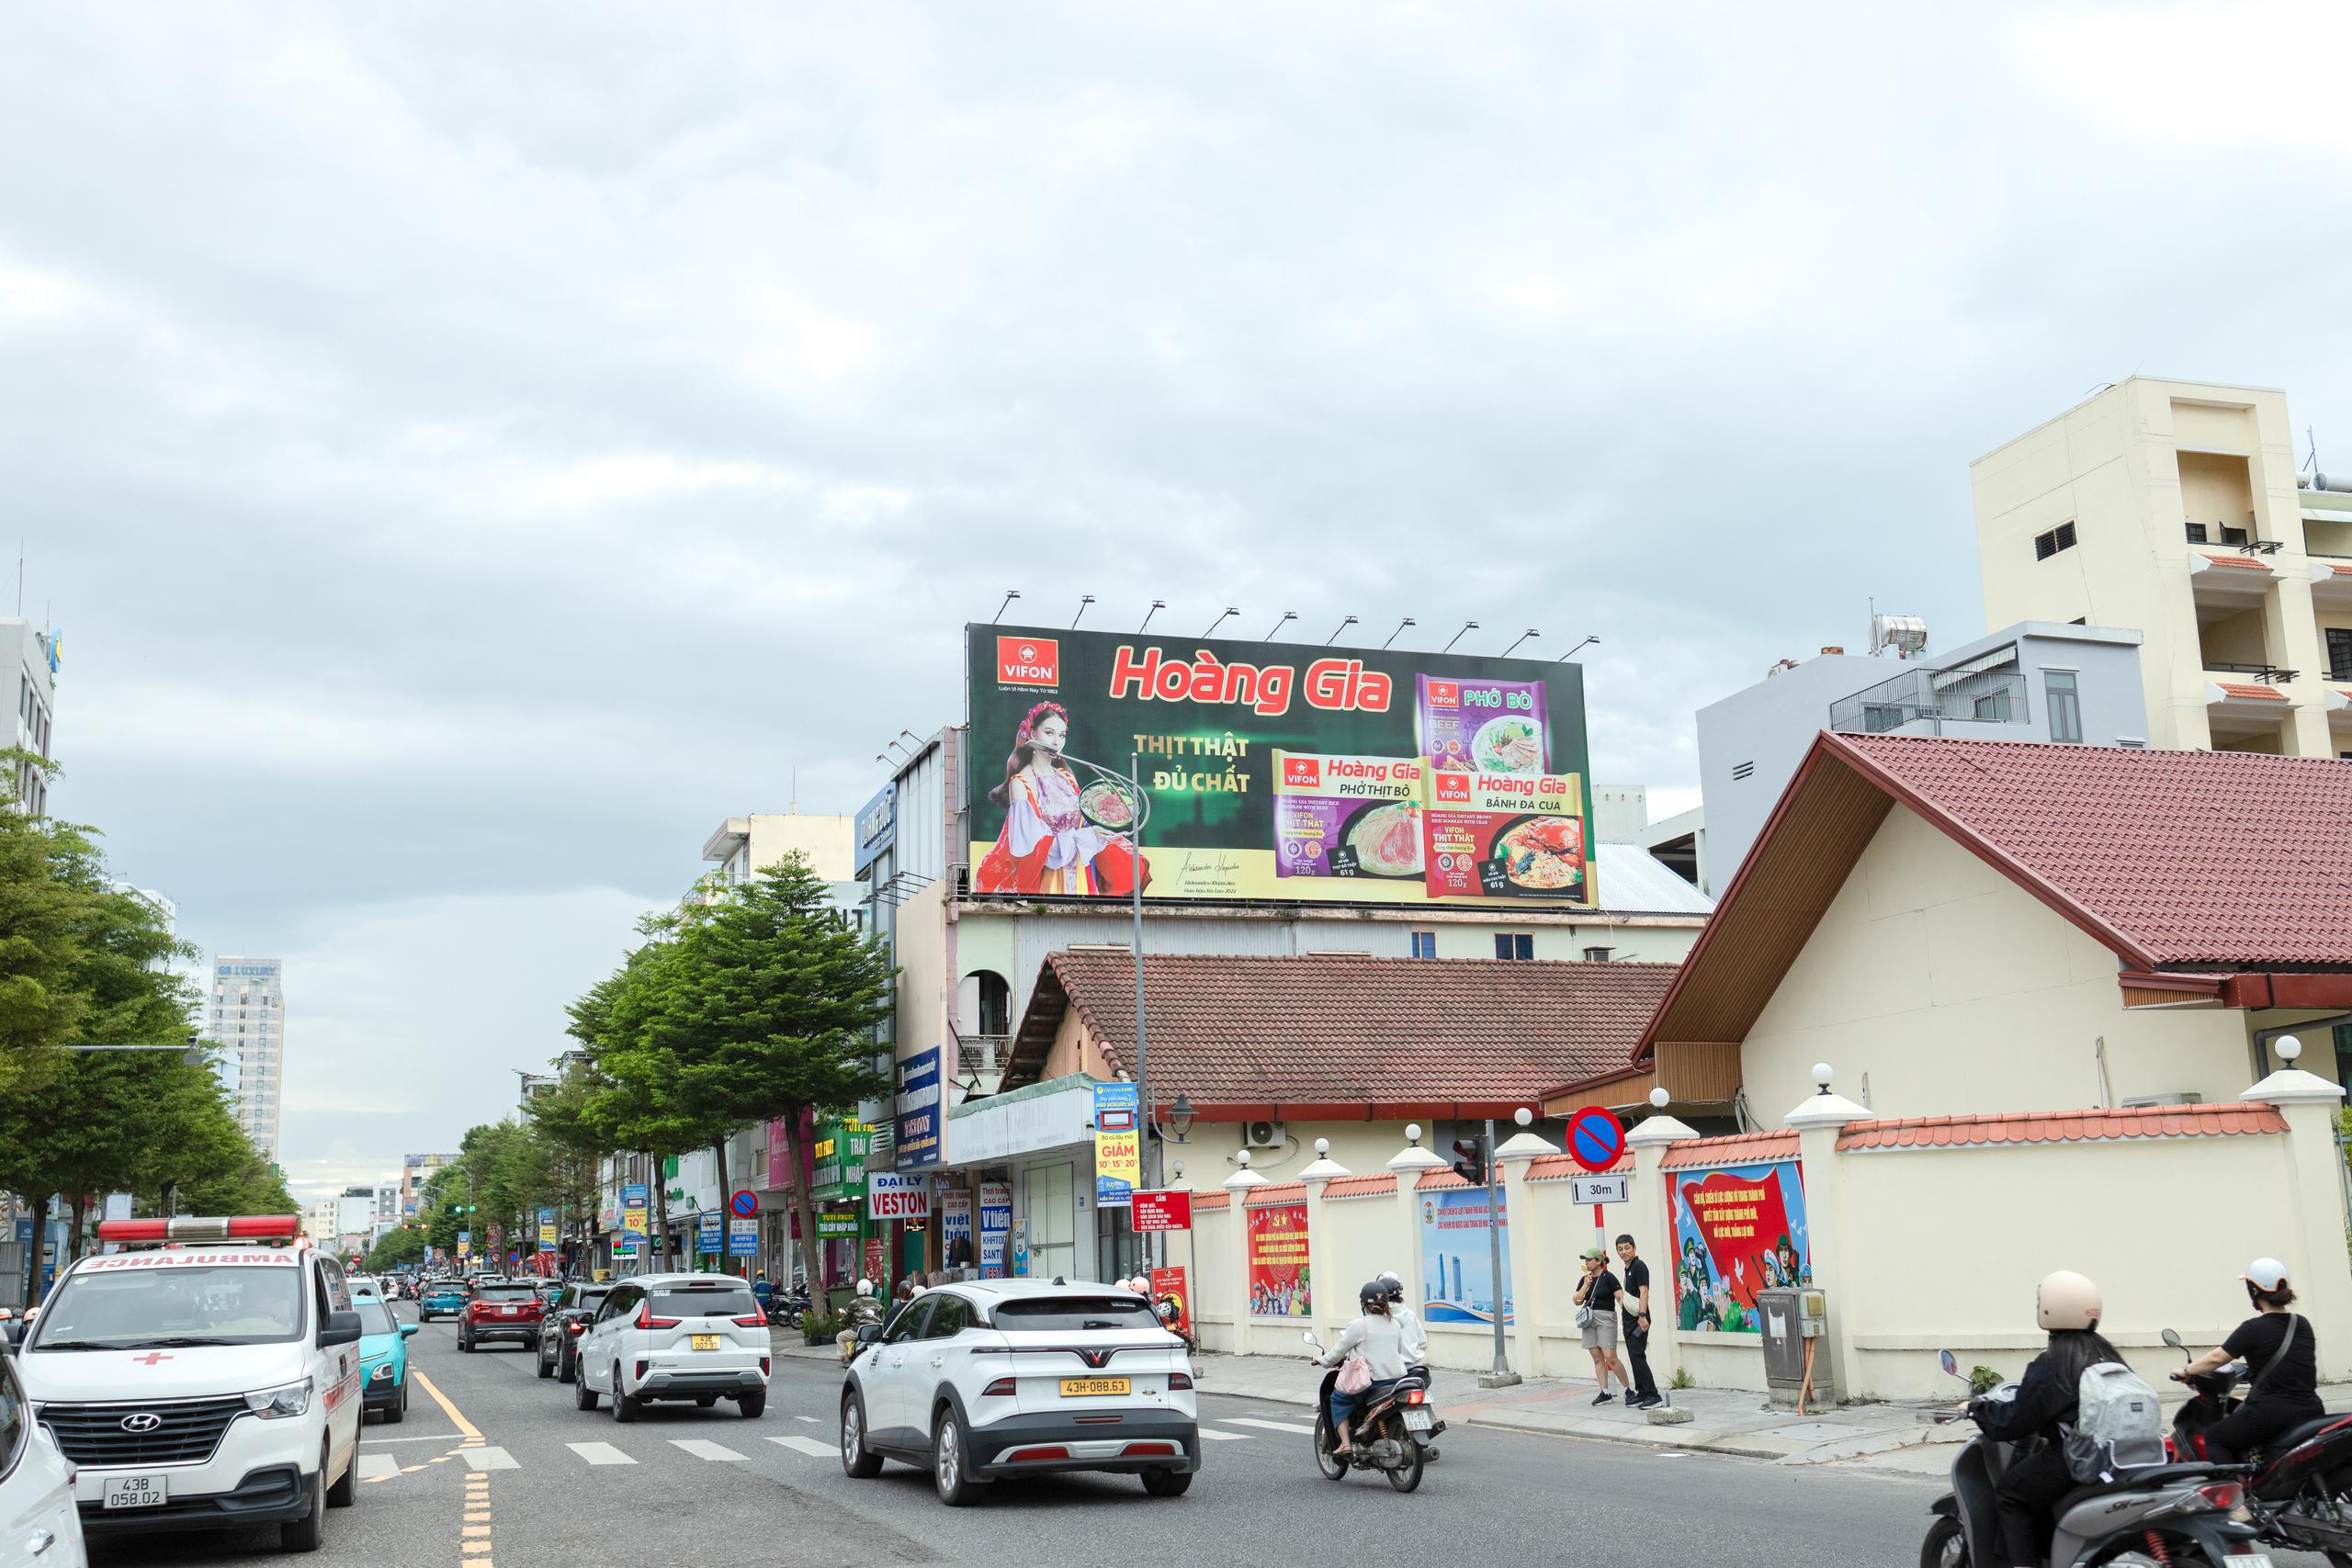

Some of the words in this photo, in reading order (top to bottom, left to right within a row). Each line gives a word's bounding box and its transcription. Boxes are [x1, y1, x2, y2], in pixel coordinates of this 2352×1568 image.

[1004, 665, 1052, 679] VIFON
[1109, 645, 1295, 716] Hoàng
[1304, 658, 1392, 713] Gia
[1464, 687, 1501, 707] PHỞ
[1507, 691, 1532, 709] BÒ
[1429, 720, 1460, 728] BEEF
[1134, 735, 1187, 760] THỊT
[1191, 731, 1250, 762] THẬT
[1329, 760, 1386, 781] Hoàng
[1392, 763, 1420, 779] Gia
[1153, 764, 1187, 791] ĐỦ
[1191, 764, 1250, 792] CHẤT
[1288, 775, 1317, 784] VIFON
[1477, 774, 1534, 795] Hoàng
[1540, 778, 1566, 795] Gia
[1340, 781, 1366, 795] PHỞ
[1369, 785, 1392, 797] THỊT
[1395, 784, 1409, 796] BÒ
[1440, 791, 1467, 799] VIFON
[1486, 796, 1517, 808] BÁNH
[1520, 800, 1535, 809] ĐA
[1539, 801, 1561, 810] CUA
[1433, 834, 1452, 842] THỊT
[1453, 833, 1475, 843] THẬT
[235, 966, 277, 976] LUXURY
[851, 1134, 865, 1156] TRÁI
[1102, 1142, 1134, 1157] GIẢM
[845, 1163, 865, 1186] NHẬP
[877, 1178, 903, 1188] ĐẠI
[907, 1175, 922, 1186] LÝ
[1590, 1185, 1611, 1194] 30m
[1705, 1189, 1714, 1203] CHIẾN
[1724, 1190, 1734, 1205] LƯỢNG
[1738, 1190, 1748, 1201] TRANG
[1748, 1187, 1758, 1201] THÀNH
[873, 1191, 927, 1215] VESTON
[628, 1218, 644, 1227] 10%
[1703, 1207, 1713, 1224] QUYẾT
[1725, 1209, 1734, 1224] DỰNG
[1734, 1207, 1744, 1220] THÀNH
[1731, 1224, 1741, 1236] THẮNG
[983, 1249, 1002, 1259] SANTI
[984, 1268, 1001, 1279] VEST
[1067, 1382, 1125, 1393] 43H-088.63
[123, 1479, 149, 1491] 43B
[111, 1492, 160, 1506] 058.02
